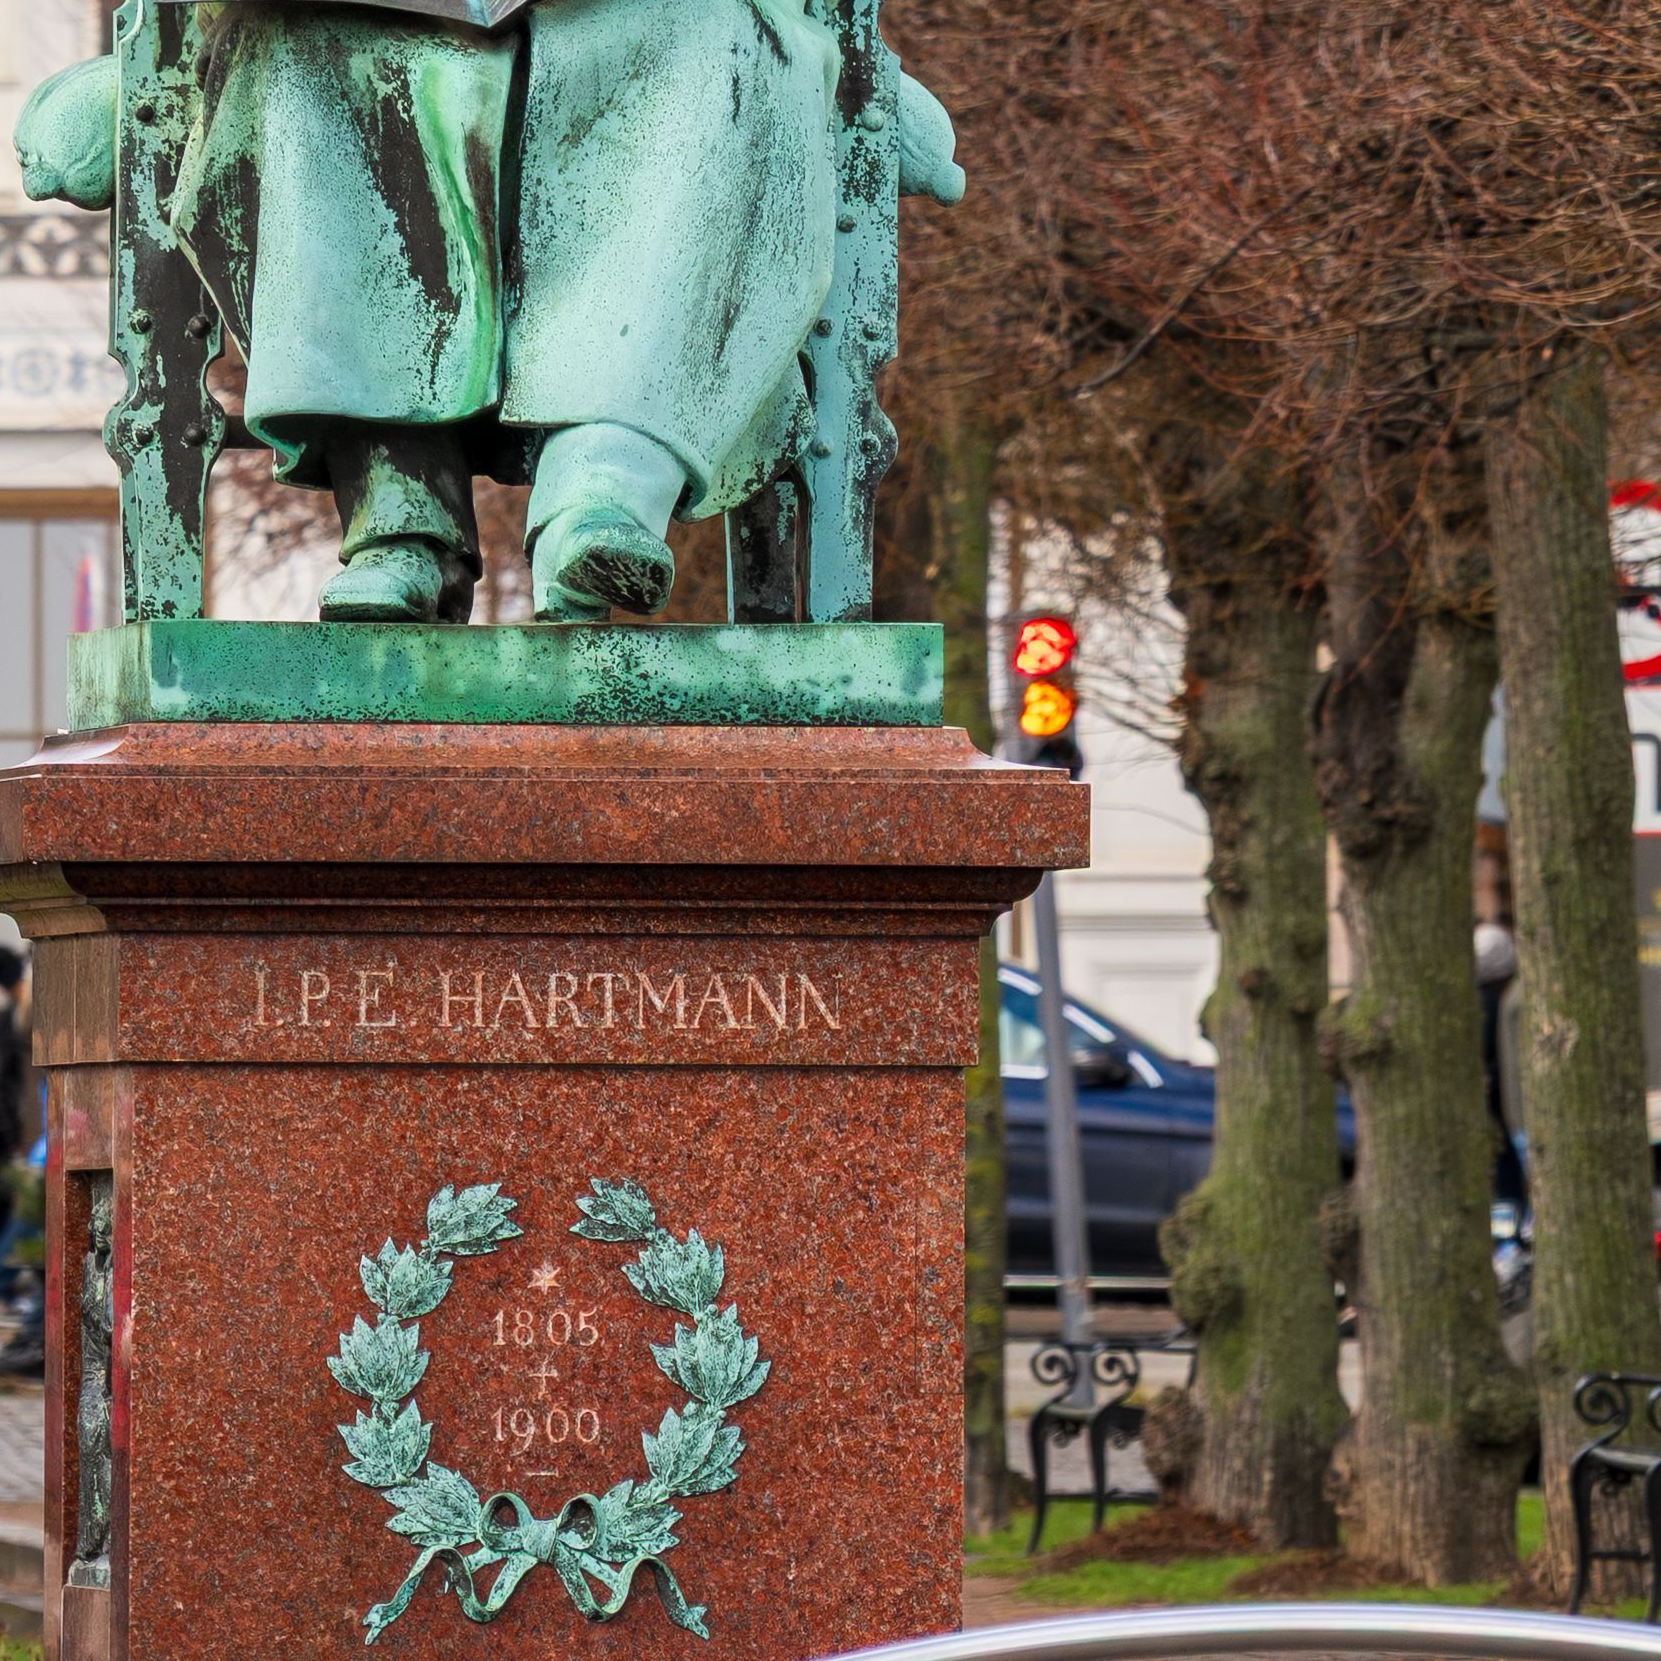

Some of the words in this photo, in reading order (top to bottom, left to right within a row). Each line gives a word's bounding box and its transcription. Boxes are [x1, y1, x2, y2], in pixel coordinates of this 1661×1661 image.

[436, 967, 841, 1030] HARTMANN
[492, 1308, 599, 1346] 1805
[490, 1407, 600, 1457] 1900
